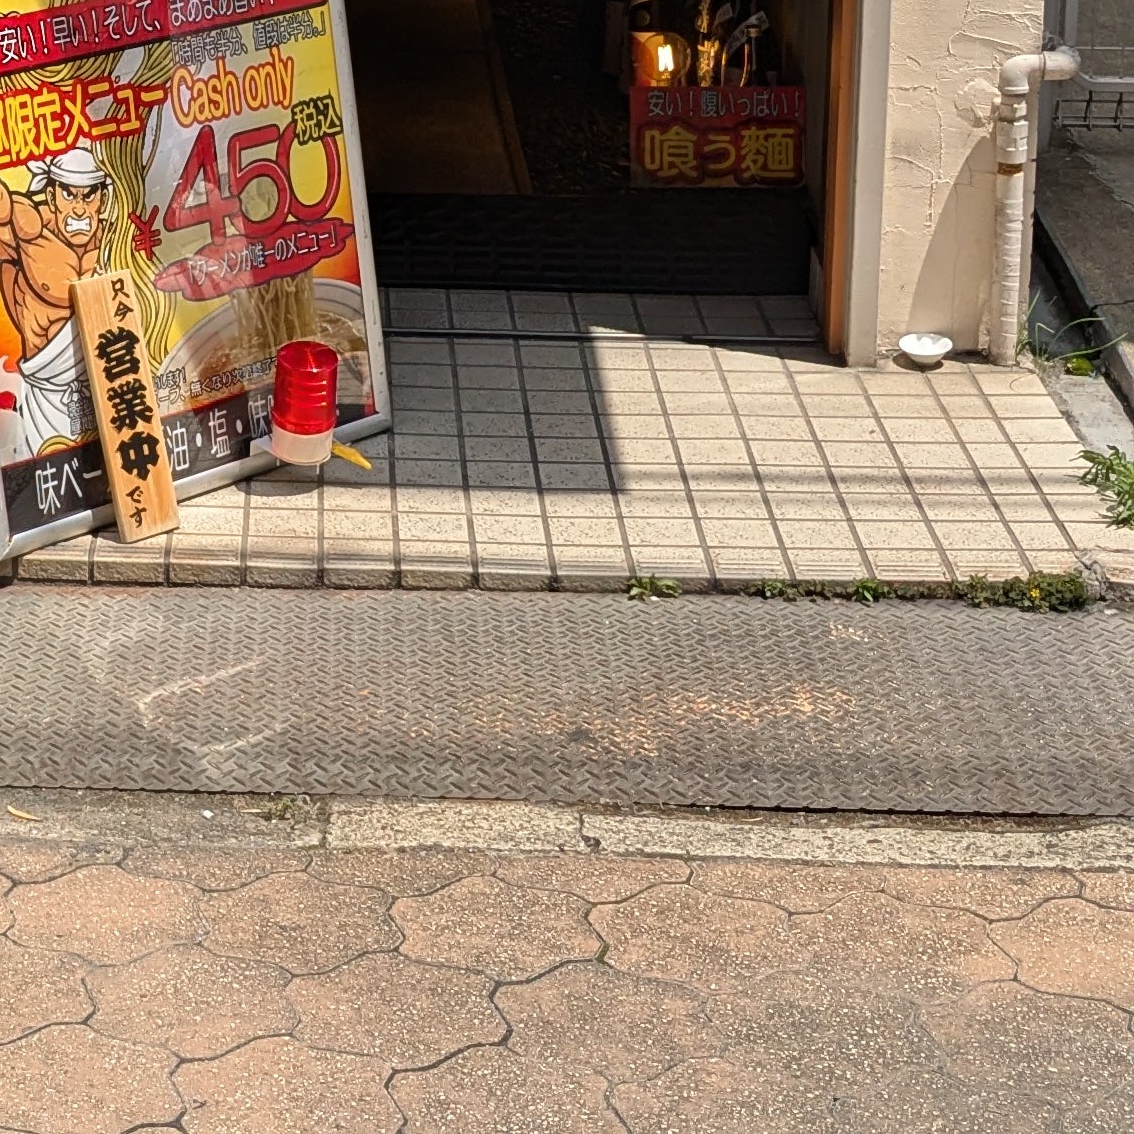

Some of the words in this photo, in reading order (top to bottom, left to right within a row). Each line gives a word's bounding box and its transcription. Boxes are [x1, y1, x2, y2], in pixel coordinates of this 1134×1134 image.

[172, 56, 242, 125] Cash
[244, 44, 294, 110] only
[291, 92, 345, 146] 税込
[164, 390, 275, 473] 油・塩・味
